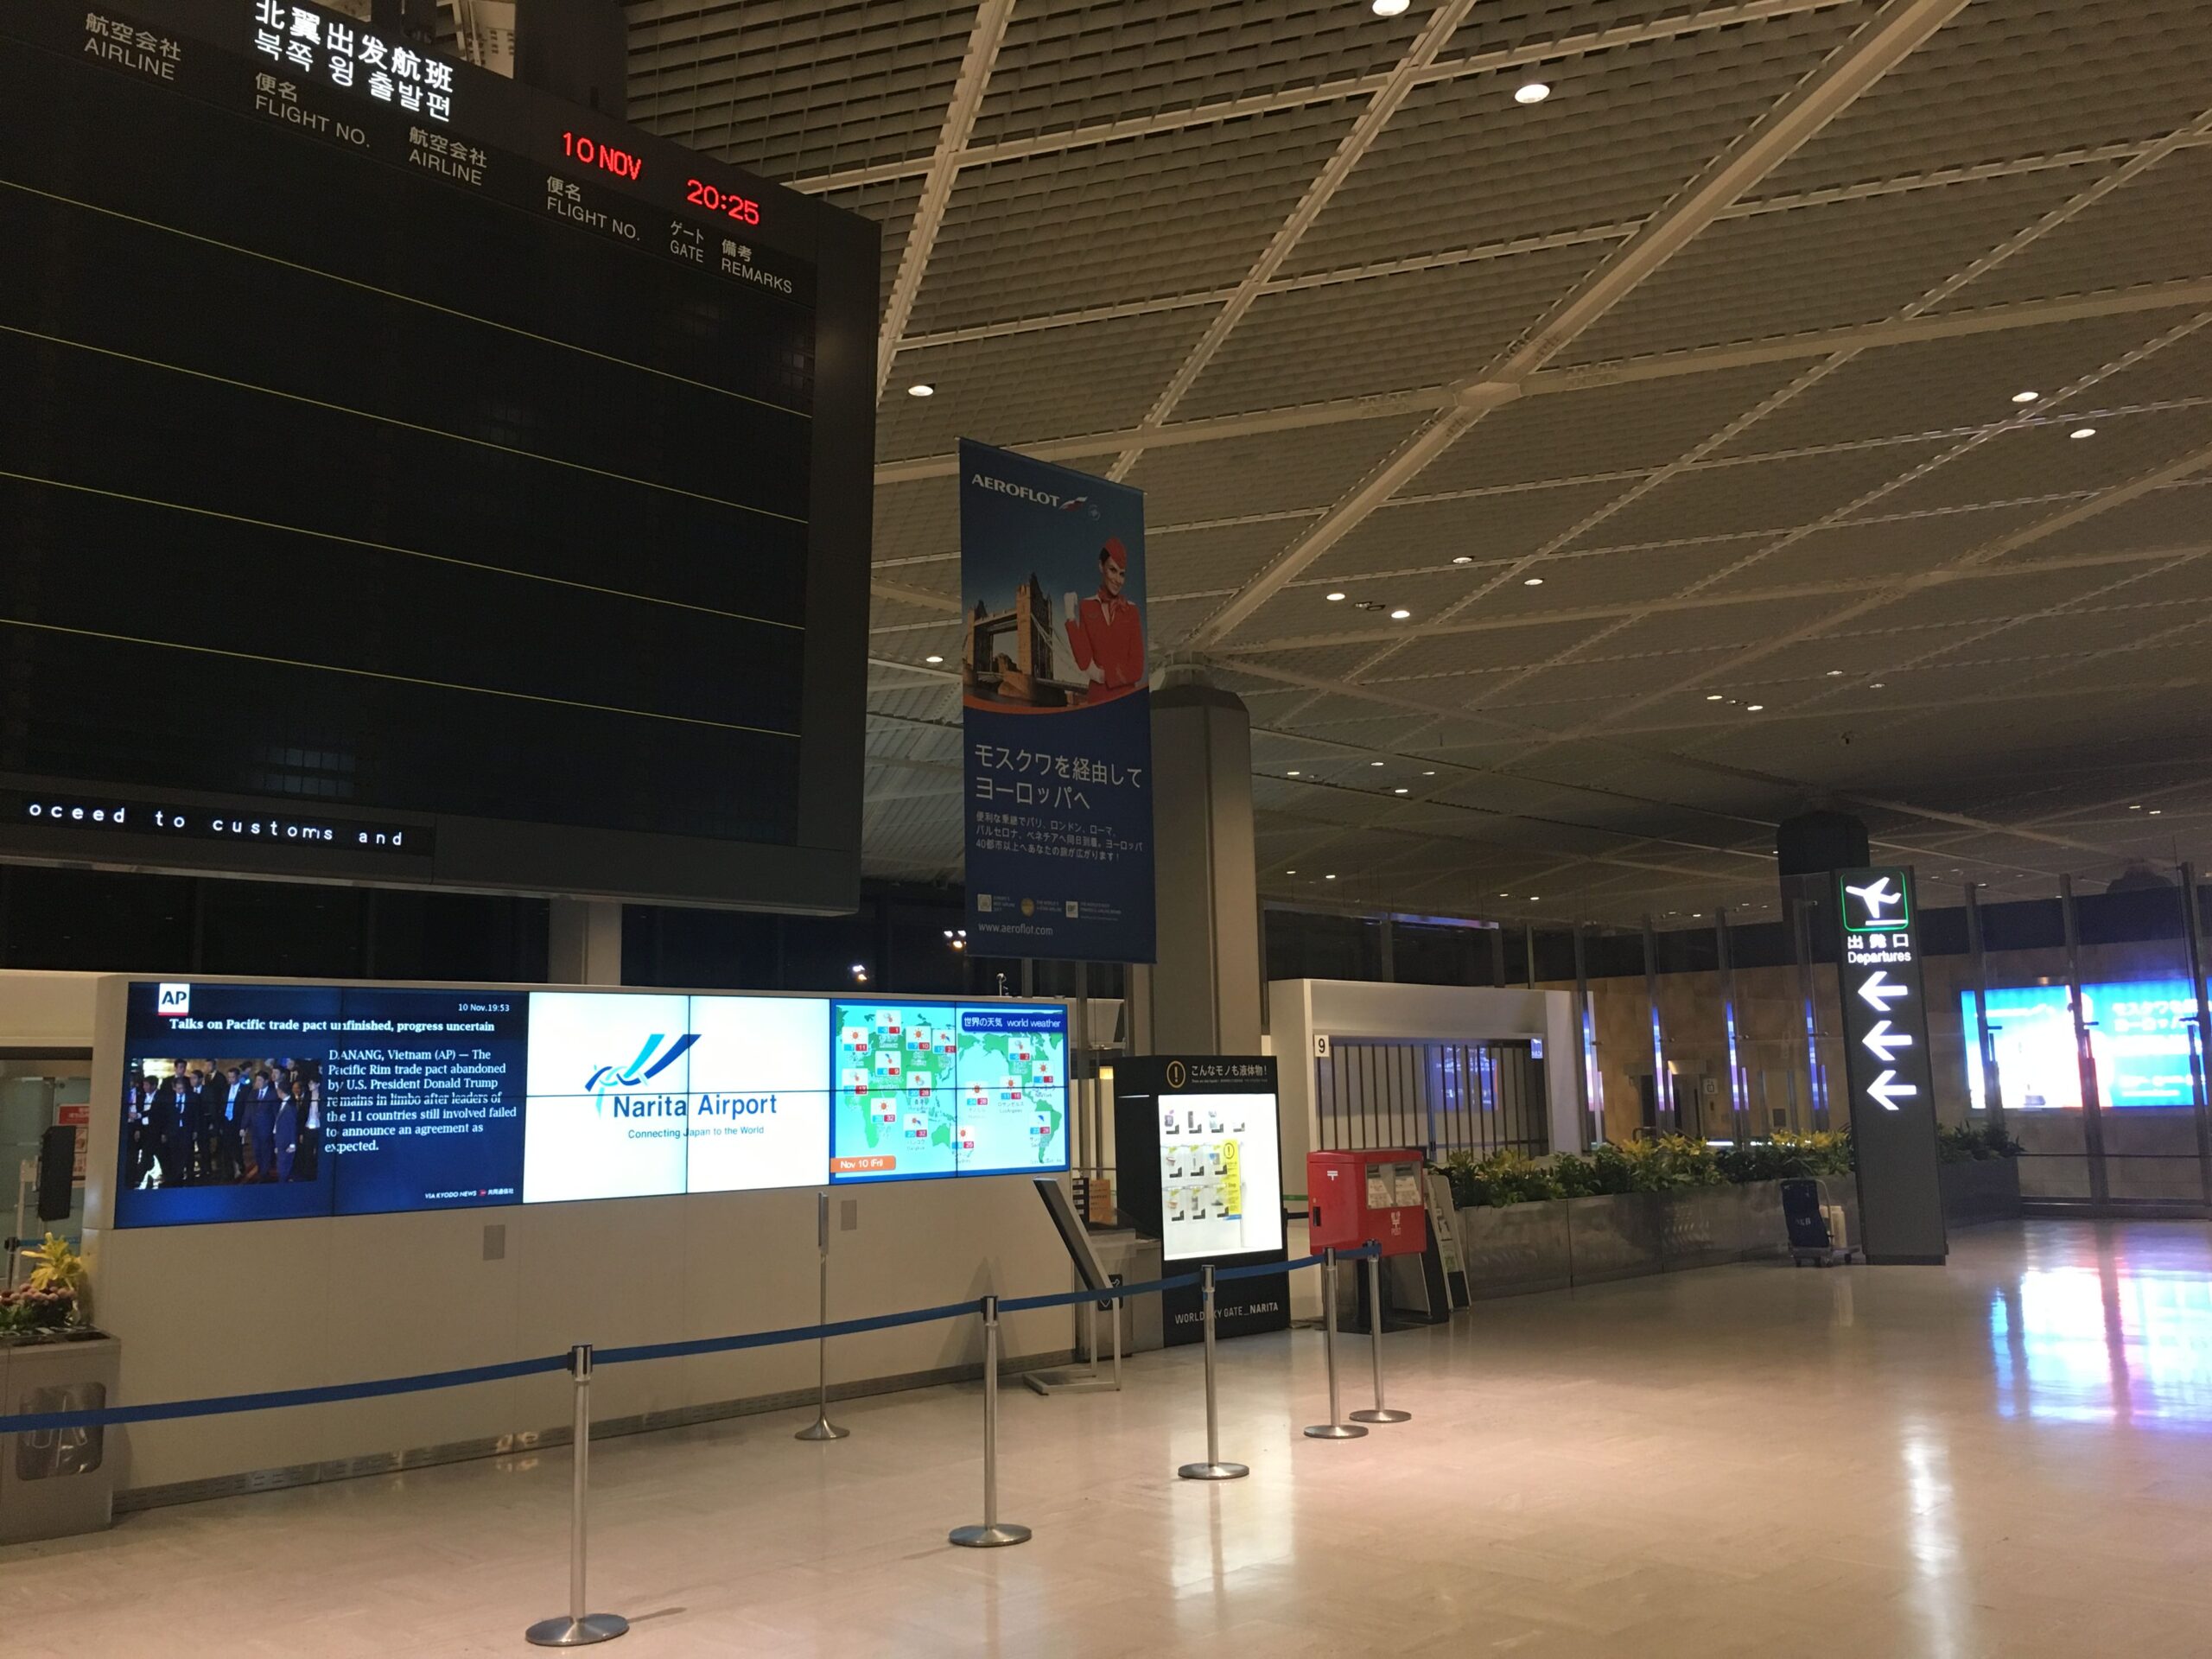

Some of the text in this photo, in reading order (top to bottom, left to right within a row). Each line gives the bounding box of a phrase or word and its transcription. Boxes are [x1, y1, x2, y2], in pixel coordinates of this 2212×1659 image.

[85, 13, 182, 61] 航空会社
[256, 0, 454, 92] 北翼出发航班
[84, 37, 175, 80] AIRLINE
[254, 29, 450, 122] 북쪽 윙 출발편
[255, 72, 297, 103] 便名
[255, 95, 371, 149] FLIGHT NO.
[409, 126, 487, 168] 航空会社
[563, 132, 642, 181] 10 NOV
[409, 149, 482, 186] AIRLINE
[547, 175, 581, 203] 便名
[687, 179, 760, 226] 20:25
[547, 197, 640, 242] FLIGHT NO.
[670, 220, 704, 245] ゲート
[670, 239, 704, 264] GATE
[721, 238, 753, 262] 備考
[721, 257, 792, 295] REMARKS
[971, 474, 1061, 507] AEROFLOT
[975, 744, 1142, 789] モスクワを経由して
[976, 777, 1090, 810] ヨーロッパへ
[29, 804, 402, 847] oceed to customs and
[978, 923, 1053, 936] www.aeroflot.com
[1847, 950, 1911, 965] Departures
[162, 990, 187, 1005] AP
[458, 1003, 468, 1012] 10
[169, 1018, 203, 1030] Talks
[207, 1020, 223, 1030] on
[226, 1019, 265, 1030] Pacific
[269, 1020, 299, 1031] trade
[302, 1020, 327, 1033] pact
[397, 1021, 443, 1033] progress
[447, 1021, 495, 1032] uncertain
[963, 1017, 1061, 1028] 世界の天気 world weather
[388, 1049, 432, 1060] Vietnam
[435, 1049, 456, 1060] (AP)
[471, 1049, 491, 1059] The
[1319, 1038, 1326, 1054] 9
[328, 1063, 506, 1077] Pacific Rim trade pact abandoned
[327, 1077, 499, 1092] by U.S. President Donald Trump
[327, 1091, 502, 1107] remains in limbo after leaders of
[614, 1094, 777, 1120] Narita Airport
[327, 1107, 517, 1122] the 11 countries still involved failed
[326, 1124, 484, 1137] to announce an agreement as
[628, 1125, 764, 1140] Connecting Japan to the World
[325, 1140, 379, 1154] expected.
[841, 1160, 855, 1169] Nov
[858, 1159, 869, 1167] 10
[1175, 1311, 1205, 1325] WORLD
